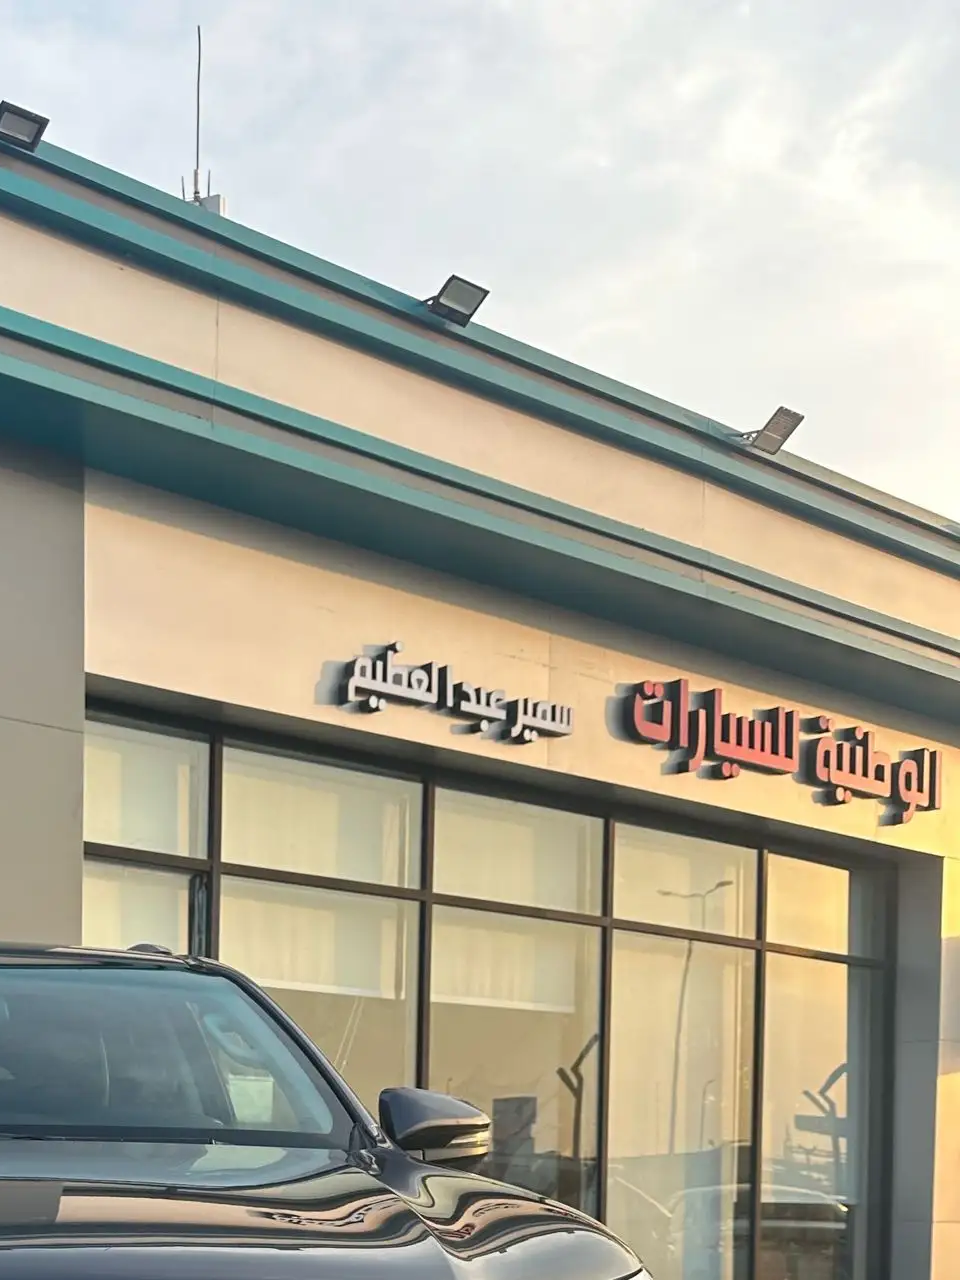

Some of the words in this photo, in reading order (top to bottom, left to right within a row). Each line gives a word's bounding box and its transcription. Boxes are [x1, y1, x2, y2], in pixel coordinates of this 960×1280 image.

[511, 697, 575, 741] سمير
[632, 678, 800, 779] للسيارات
[815, 714, 942, 825] الوطنية
